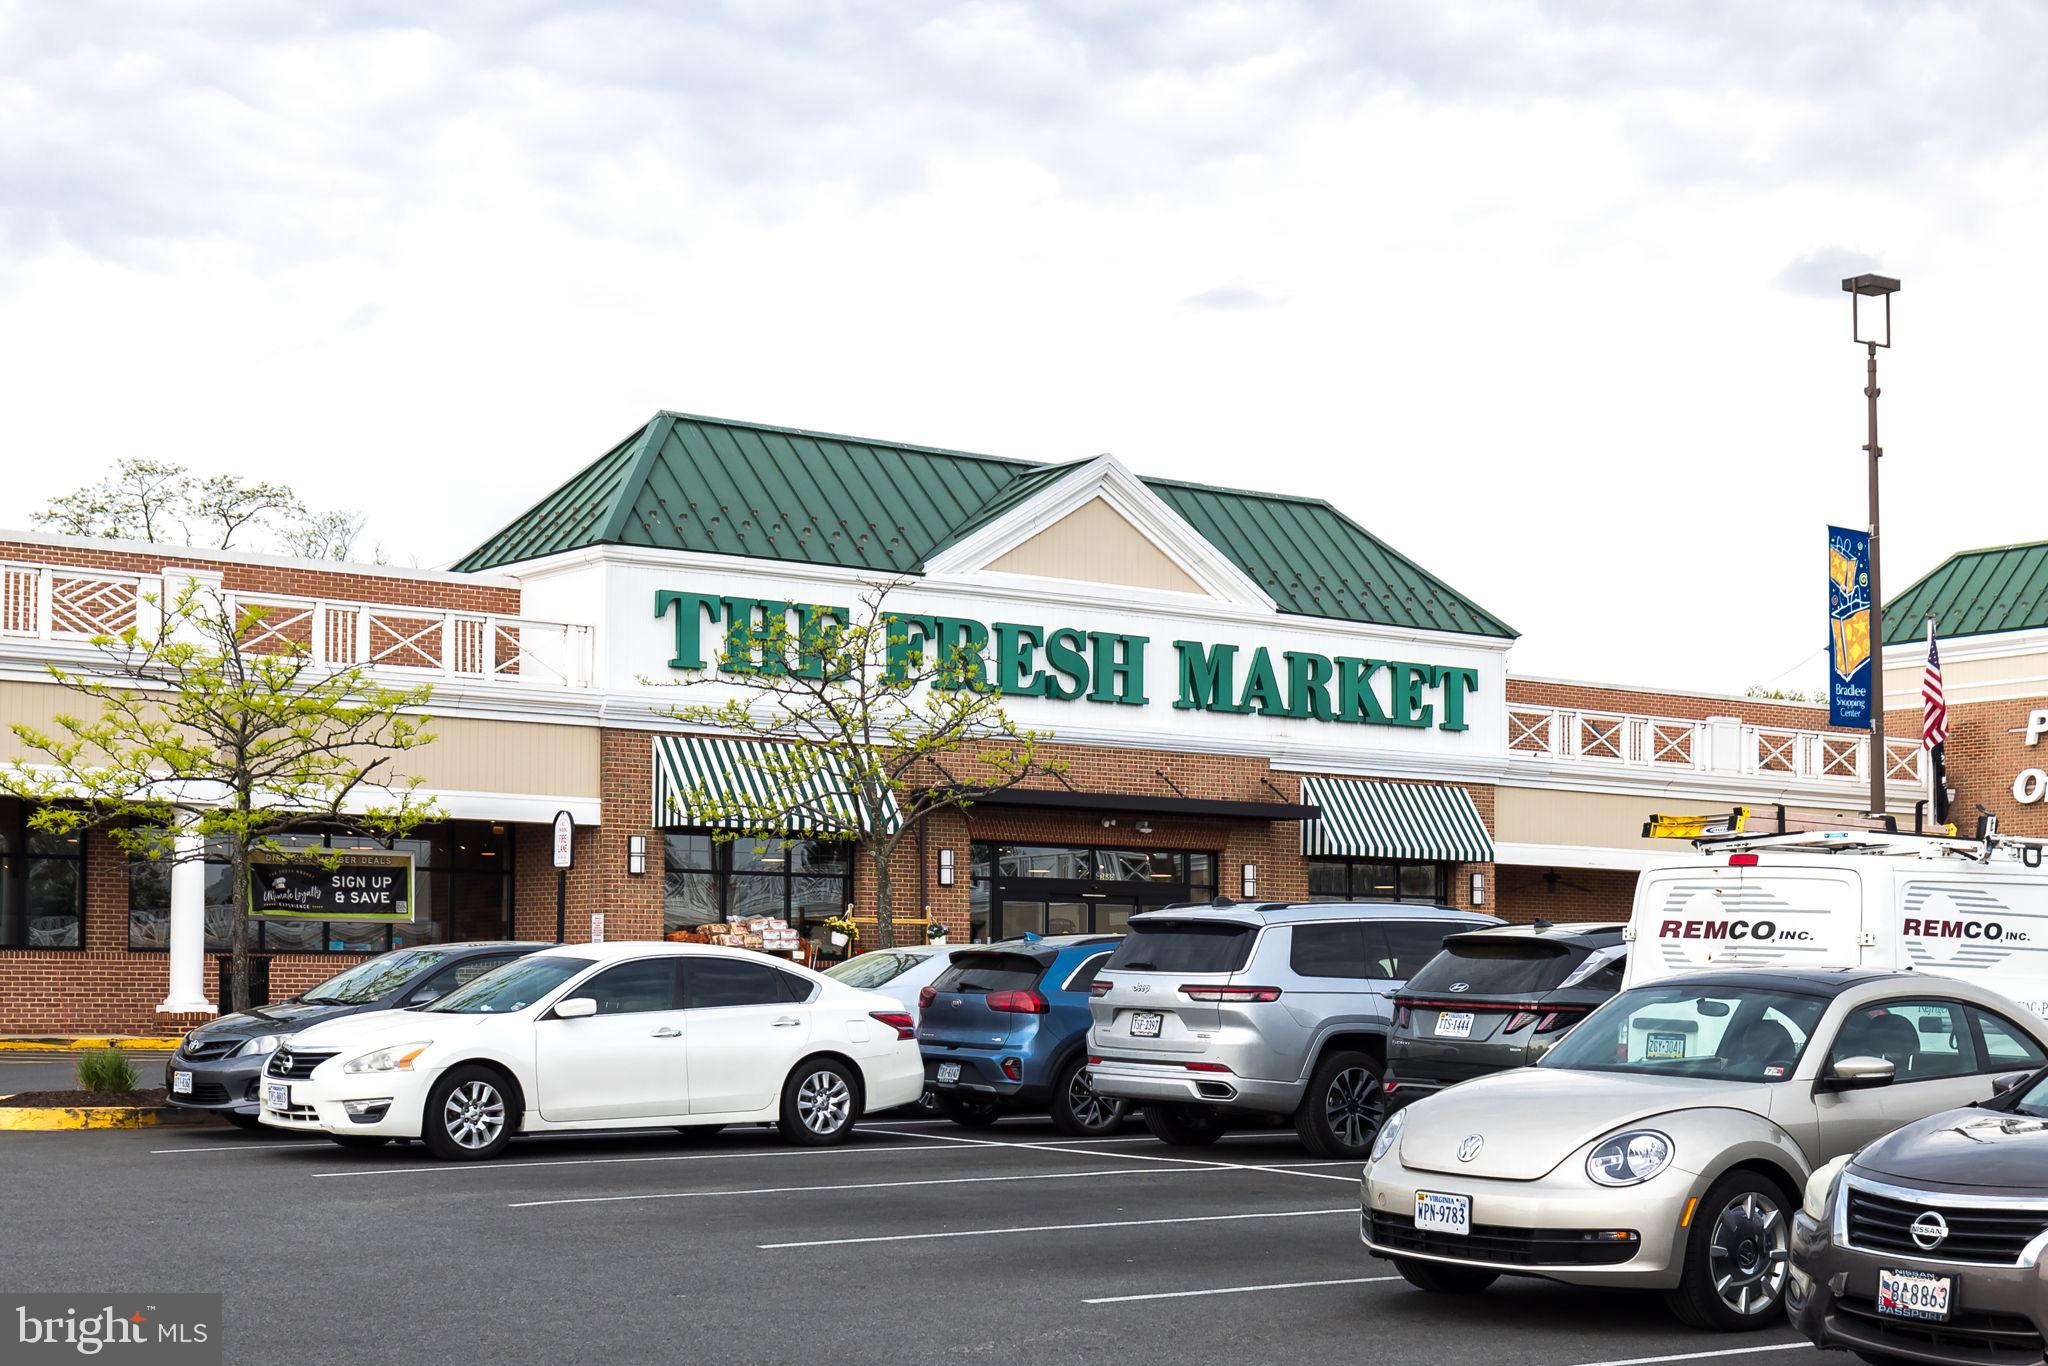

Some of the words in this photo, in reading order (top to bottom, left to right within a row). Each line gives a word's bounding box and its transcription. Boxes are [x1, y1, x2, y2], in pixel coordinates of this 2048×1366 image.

[654, 589, 852, 682] THE
[879, 611, 1150, 706] FRESH
[1173, 639, 1478, 731] MARKET
[1835, 683, 1867, 697] Bradlee
[1836, 696, 1866, 710] Shopping
[1840, 707, 1861, 718] Center
[2012, 768, 2048, 804] O
[361, 856, 392, 865] DEALS
[331, 875, 366, 888] SIGN
[371, 876, 392, 889] UP
[263, 888, 294, 902] Ultimate
[294, 885, 322, 904] Loyalty
[334, 891, 345, 904] &
[350, 891, 390, 904] SAVE
[1778, 930, 1815, 941] INC.
[2004, 931, 2031, 942] INC.
[1438, 1018, 1471, 1030] TTS-1444
[1429, 1195, 1455, 1204] VIRGINIA
[1417, 1202, 1465, 1224] WPN-9783
[1912, 1225, 1942, 1235] NISSAN
[1894, 1268, 1935, 1278] NISSAN
[1878, 1305, 1946, 1320] PASSPORT
